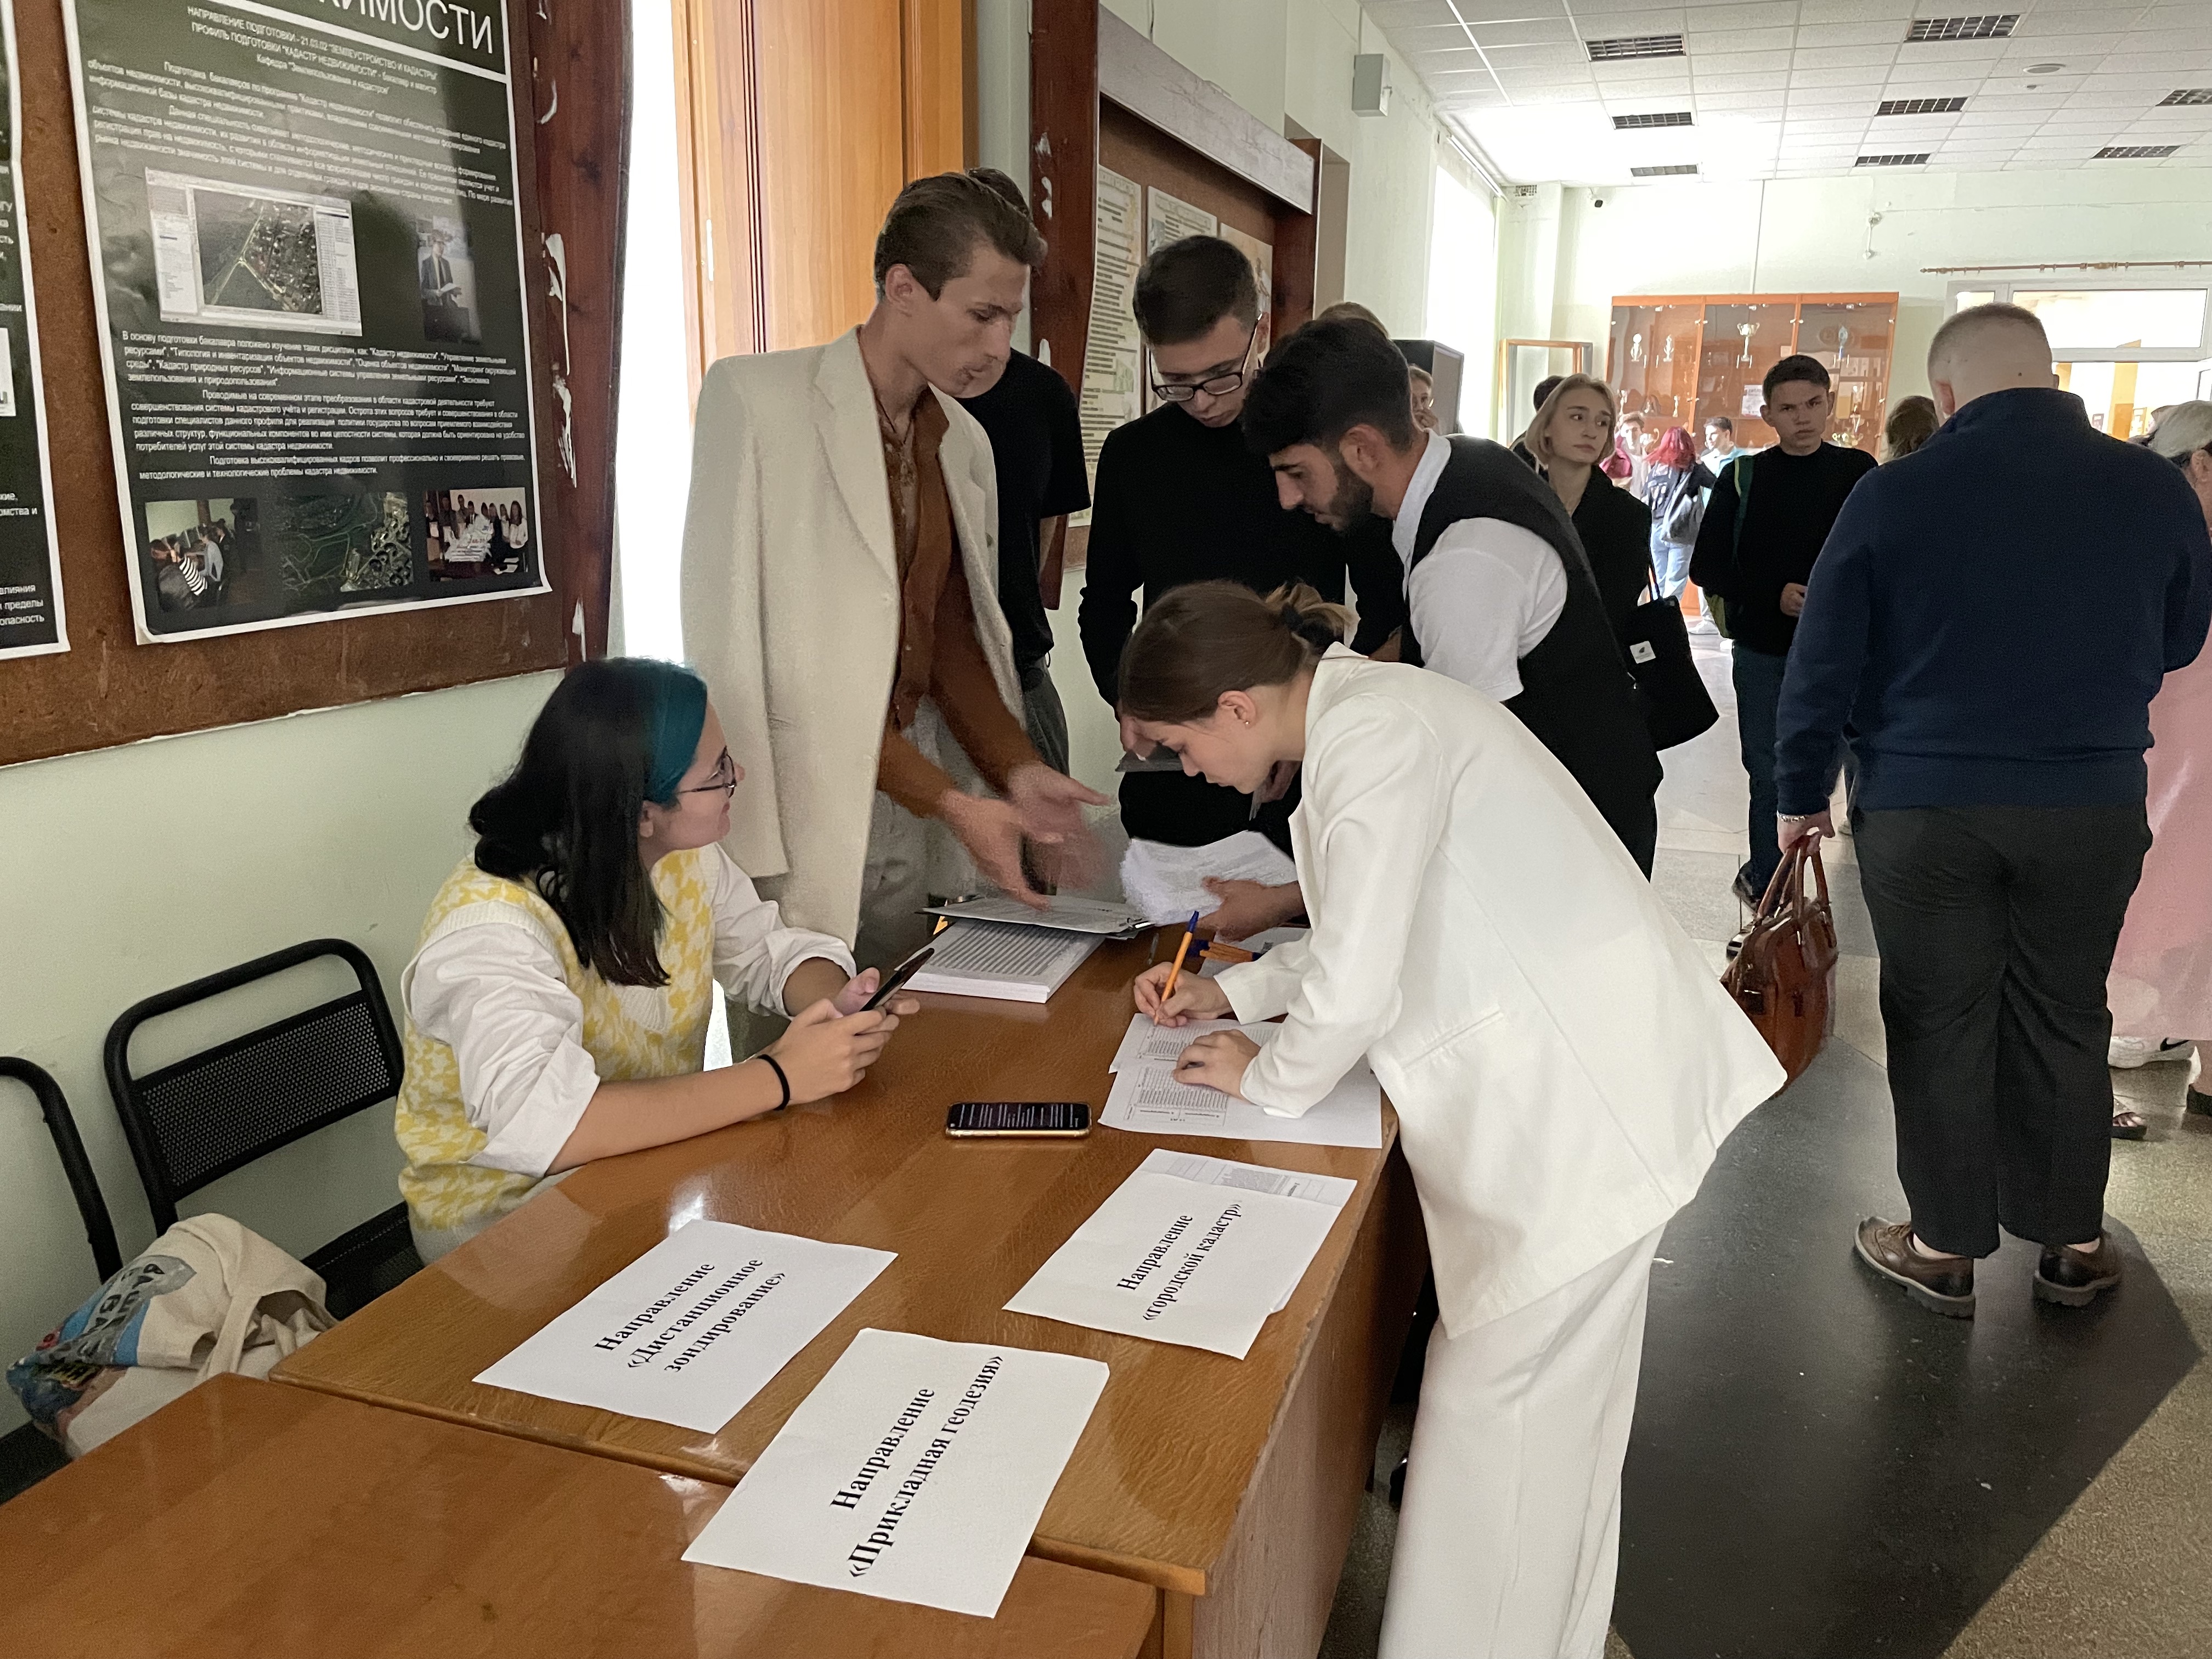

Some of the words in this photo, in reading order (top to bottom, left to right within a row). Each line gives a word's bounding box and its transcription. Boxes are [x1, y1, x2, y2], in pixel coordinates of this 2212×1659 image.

[319, 0, 493, 54] МОСТИ
[1116, 1214, 1193, 1291] Направление
[1143, 1253, 1204, 1321] «городской
[1197, 1204, 1242, 1254] кадастр»
[593, 1263, 715, 1352] Направление
[628, 1259, 763, 1369] «Дистанционное
[664, 1272, 786, 1373] зондирование»
[830, 1389, 935, 1510] Направление
[848, 1438, 951, 1577] «Прикладная
[941, 1355, 1003, 1436] геодезия»
